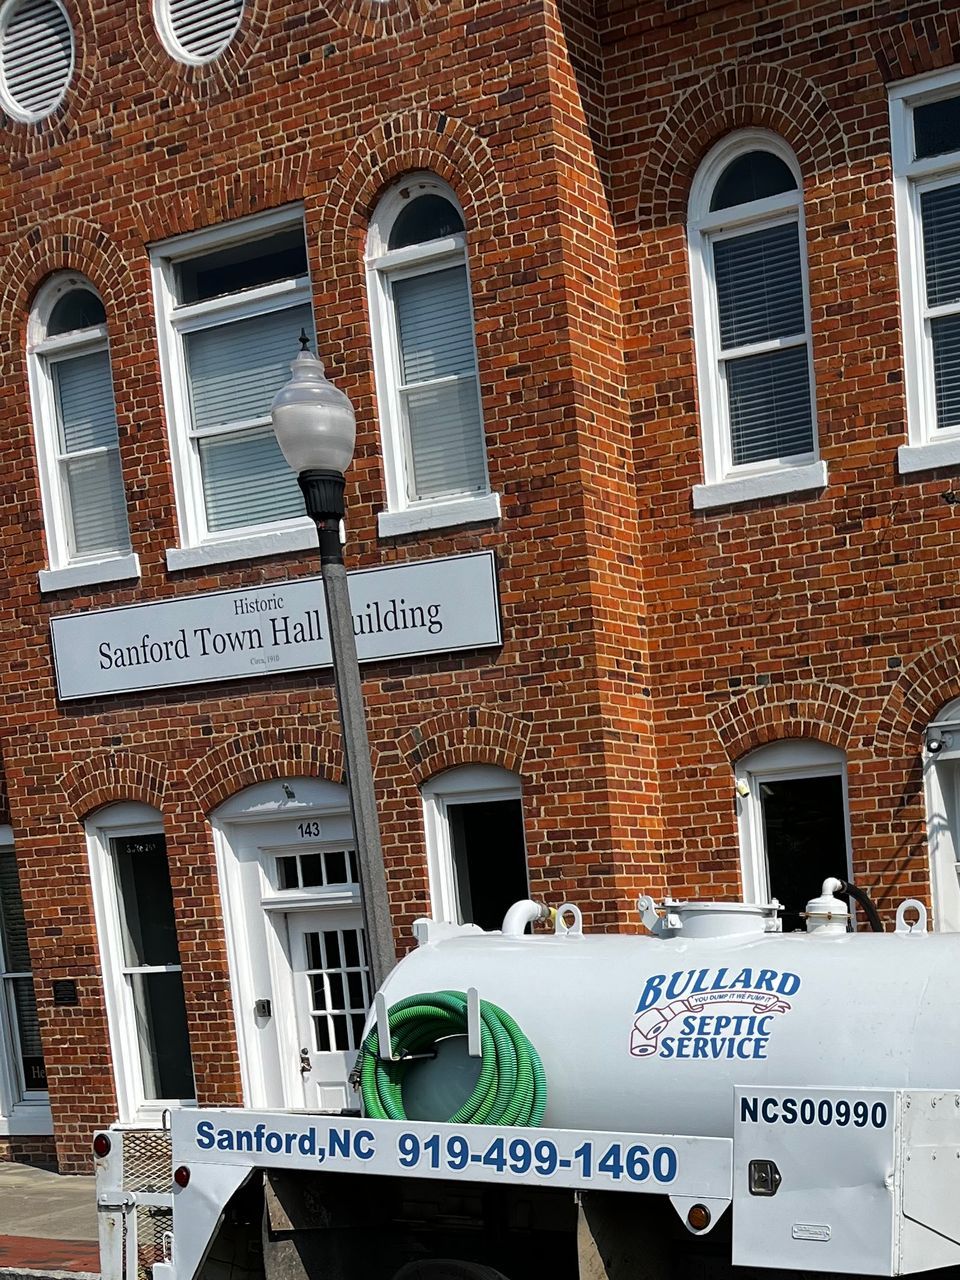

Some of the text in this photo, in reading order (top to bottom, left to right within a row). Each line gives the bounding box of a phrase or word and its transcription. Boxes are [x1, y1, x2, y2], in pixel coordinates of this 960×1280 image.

[234, 593, 284, 616] Historic
[99, 598, 443, 670] Sanford Town Hall uilding
[298, 821, 320, 838] 143
[635, 967, 801, 1014] BULLARD
[694, 995, 709, 1003] YOU
[746, 993, 764, 1001] PUMP
[680, 1015, 774, 1036] SEPTIC
[659, 1037, 769, 1059] SERVICE
[741, 1097, 887, 1128] NCS00990
[399, 1133, 678, 1182] 919-499-1460
